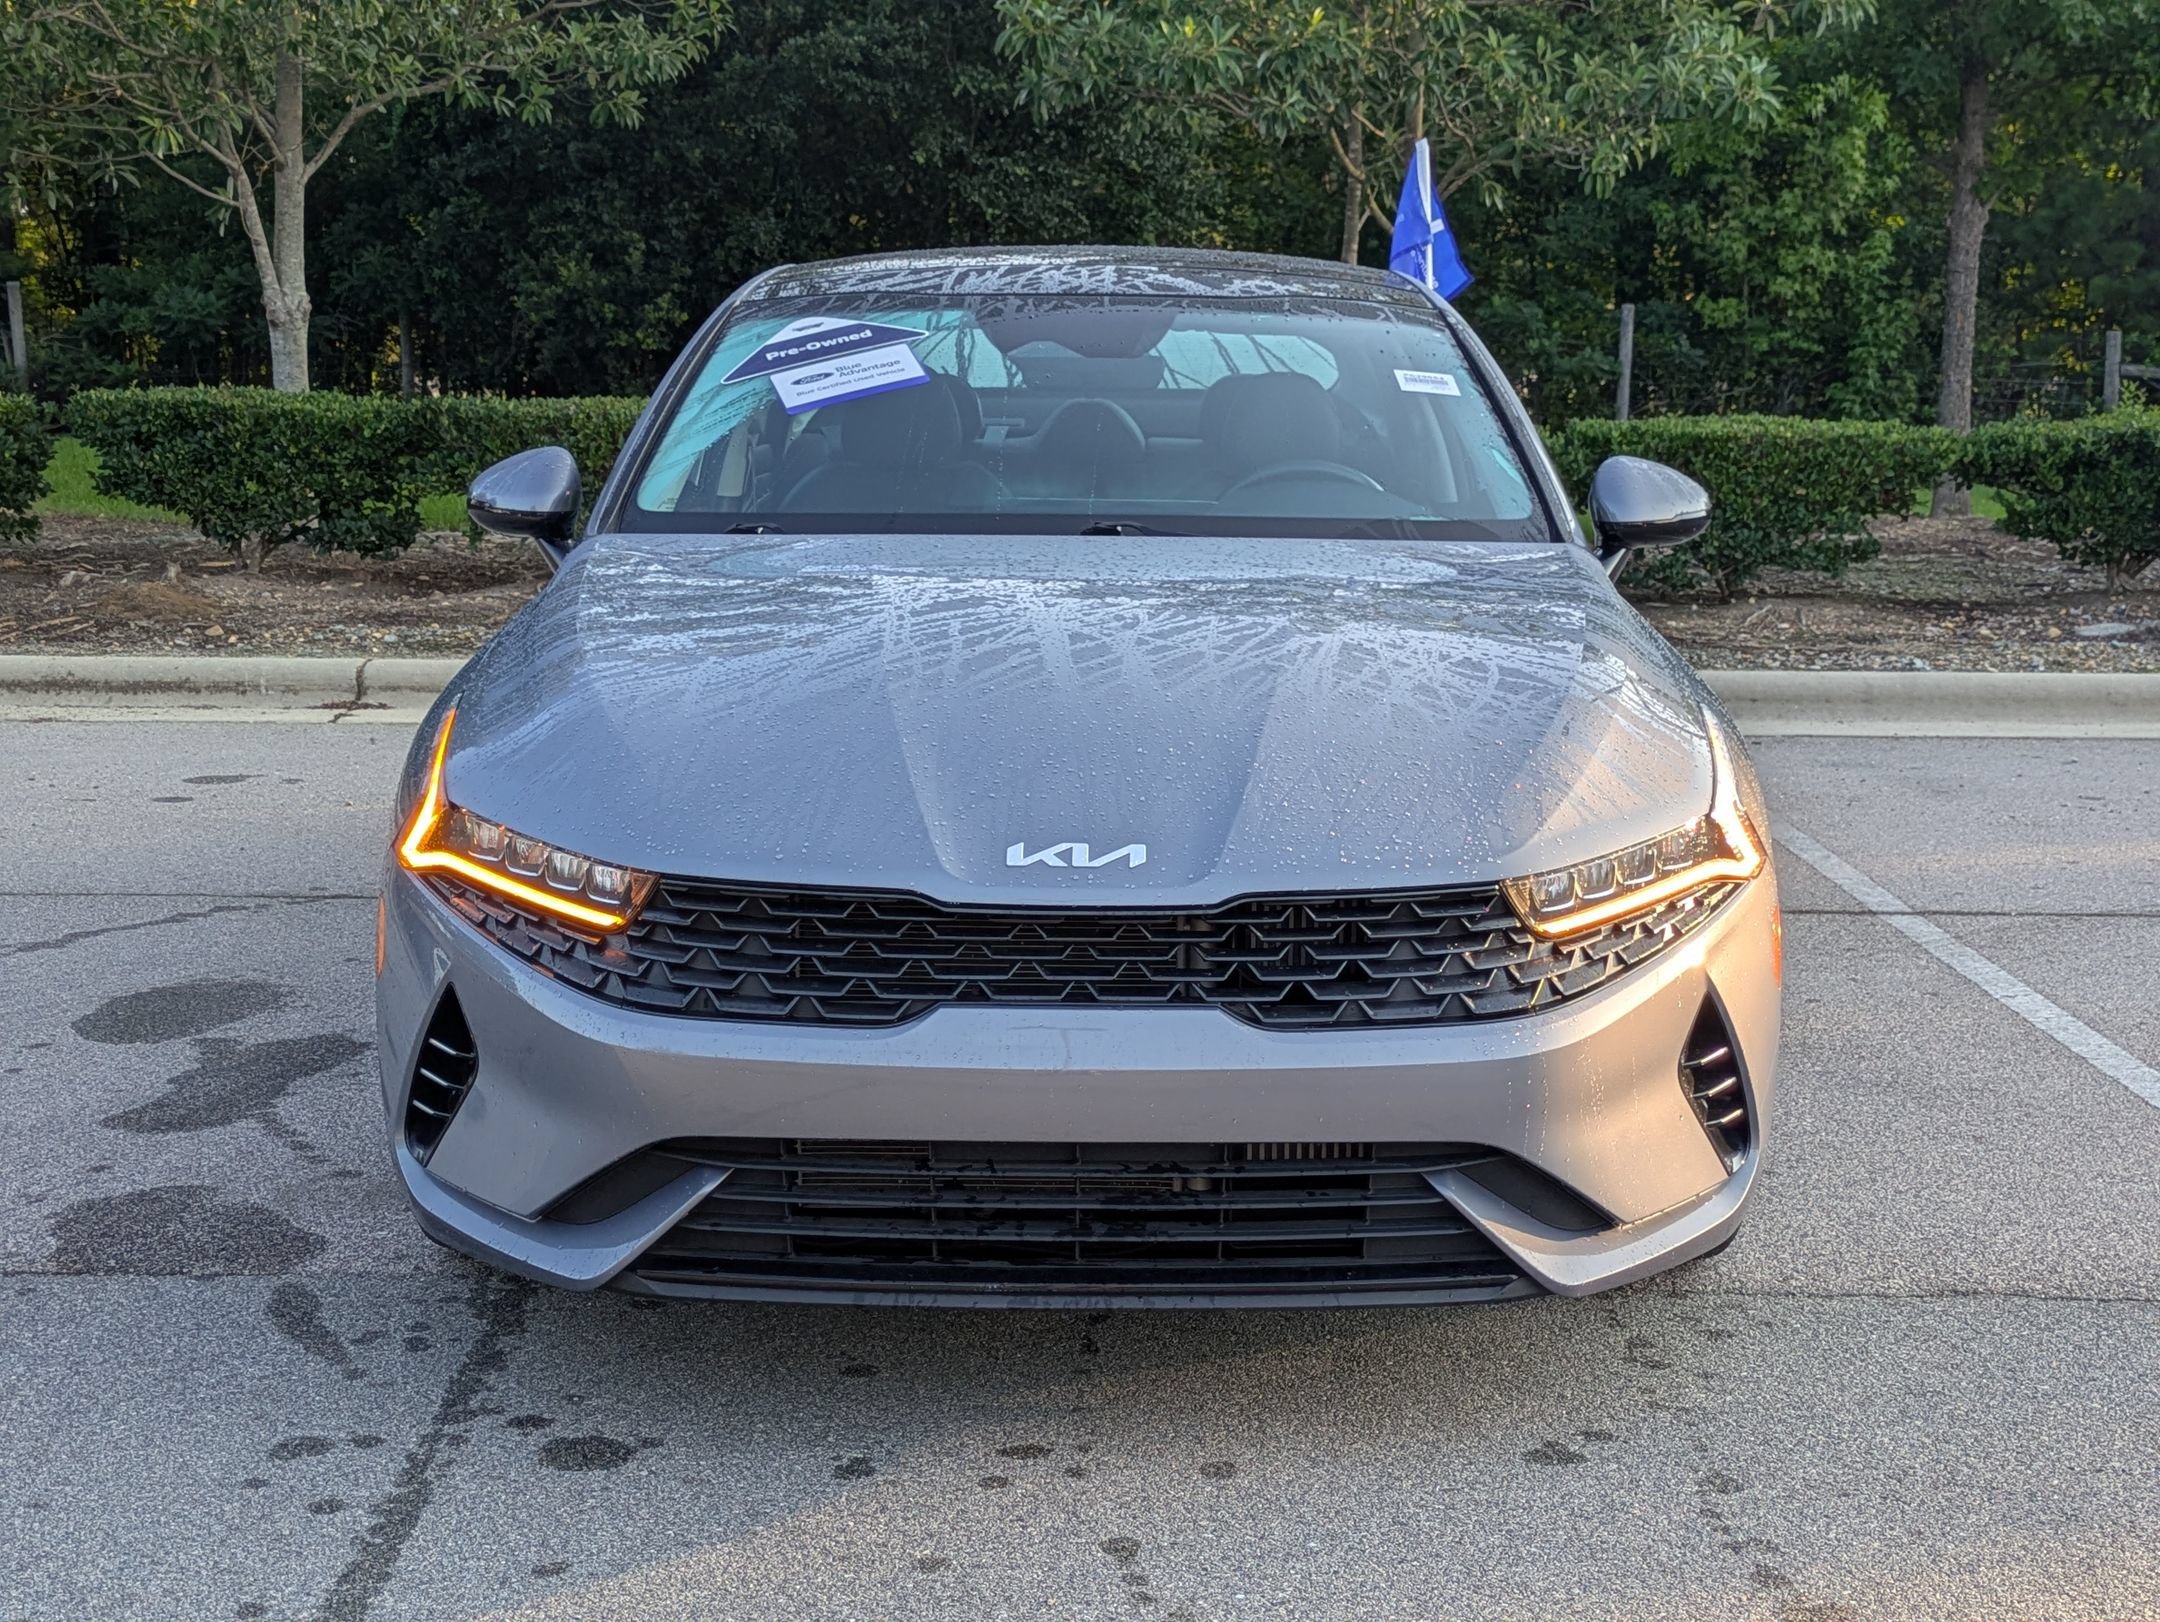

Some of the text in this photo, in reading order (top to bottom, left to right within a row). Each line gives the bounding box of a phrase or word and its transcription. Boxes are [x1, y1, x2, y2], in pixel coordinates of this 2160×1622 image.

[765, 329, 873, 360] Pre-Owned
[835, 362, 862, 373] Blue
[839, 360, 901, 377] Advantage
[796, 367, 906, 397] Blue Certified Used Vehicle
[1006, 842, 1146, 868] KIA
